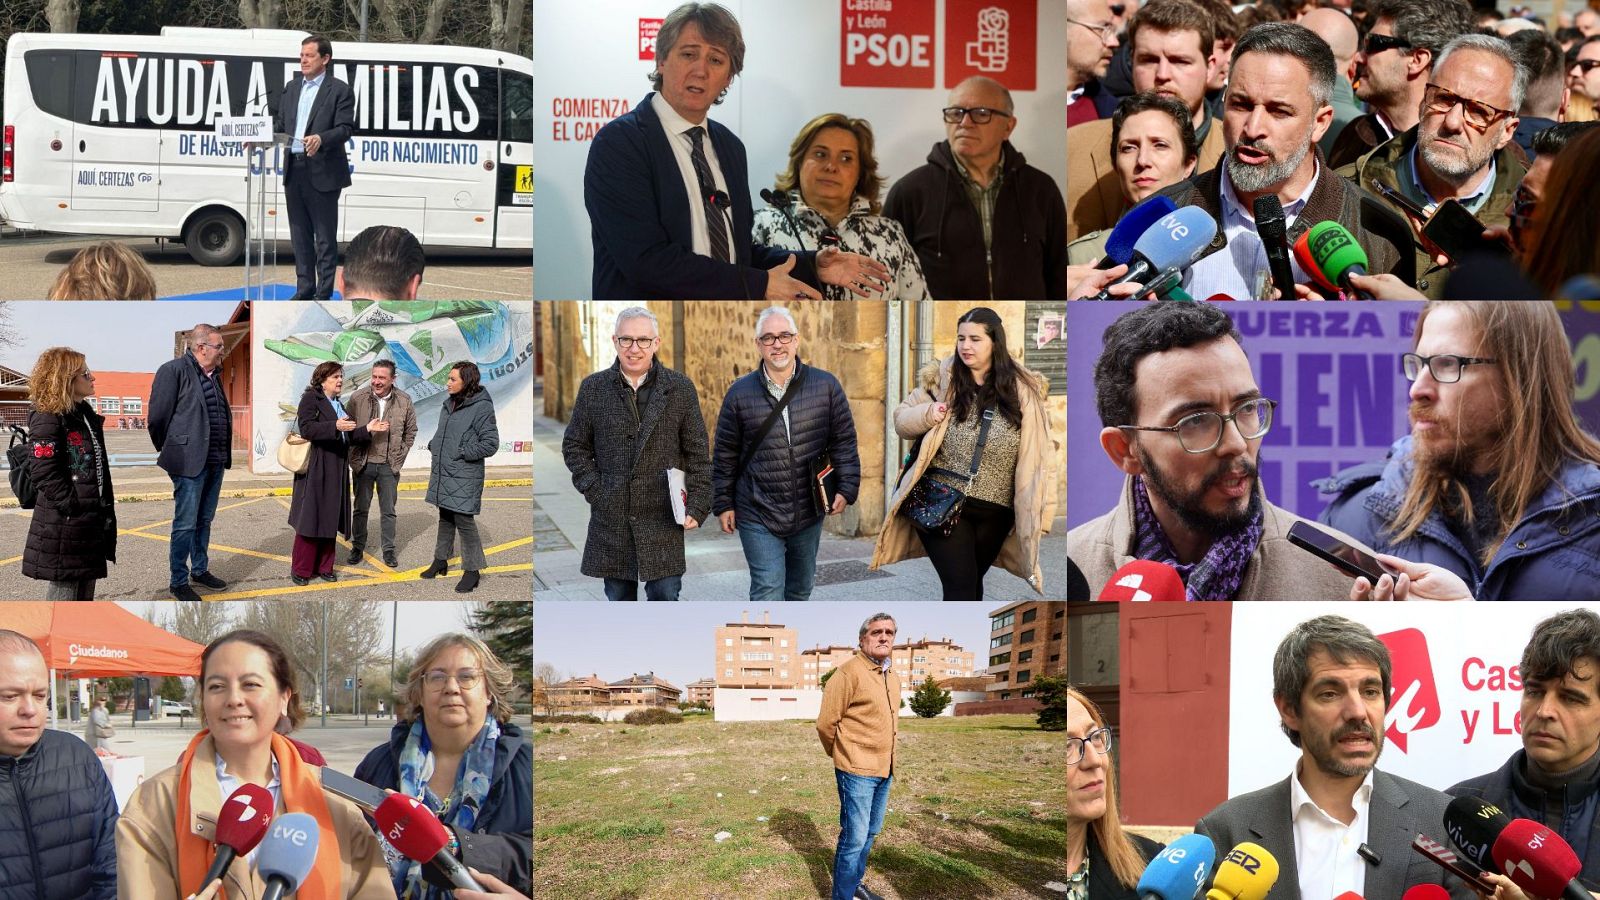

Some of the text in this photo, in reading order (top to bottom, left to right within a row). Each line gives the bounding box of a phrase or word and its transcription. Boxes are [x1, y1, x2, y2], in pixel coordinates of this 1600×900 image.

[846, 13, 886, 31] y León
[846, 33, 930, 67] PSOE
[91, 57, 231, 126] AYUDA
[244, 60, 269, 118] A
[553, 98, 629, 118] COMIENZA
[553, 121, 571, 141] EL
[179, 133, 197, 156] DE
[361, 140, 389, 162] POR
[393, 141, 478, 165] NACIMIENTO
[99, 171, 135, 187] CERTEZAS
[1161, 214, 1189, 241] tve
[1228, 310, 1384, 338] UERZA
[69, 644, 128, 659] Ciudadanos
[1097, 659, 1105, 673] 2
[1461, 710, 1480, 744] y
[273, 825, 308, 846] tve
